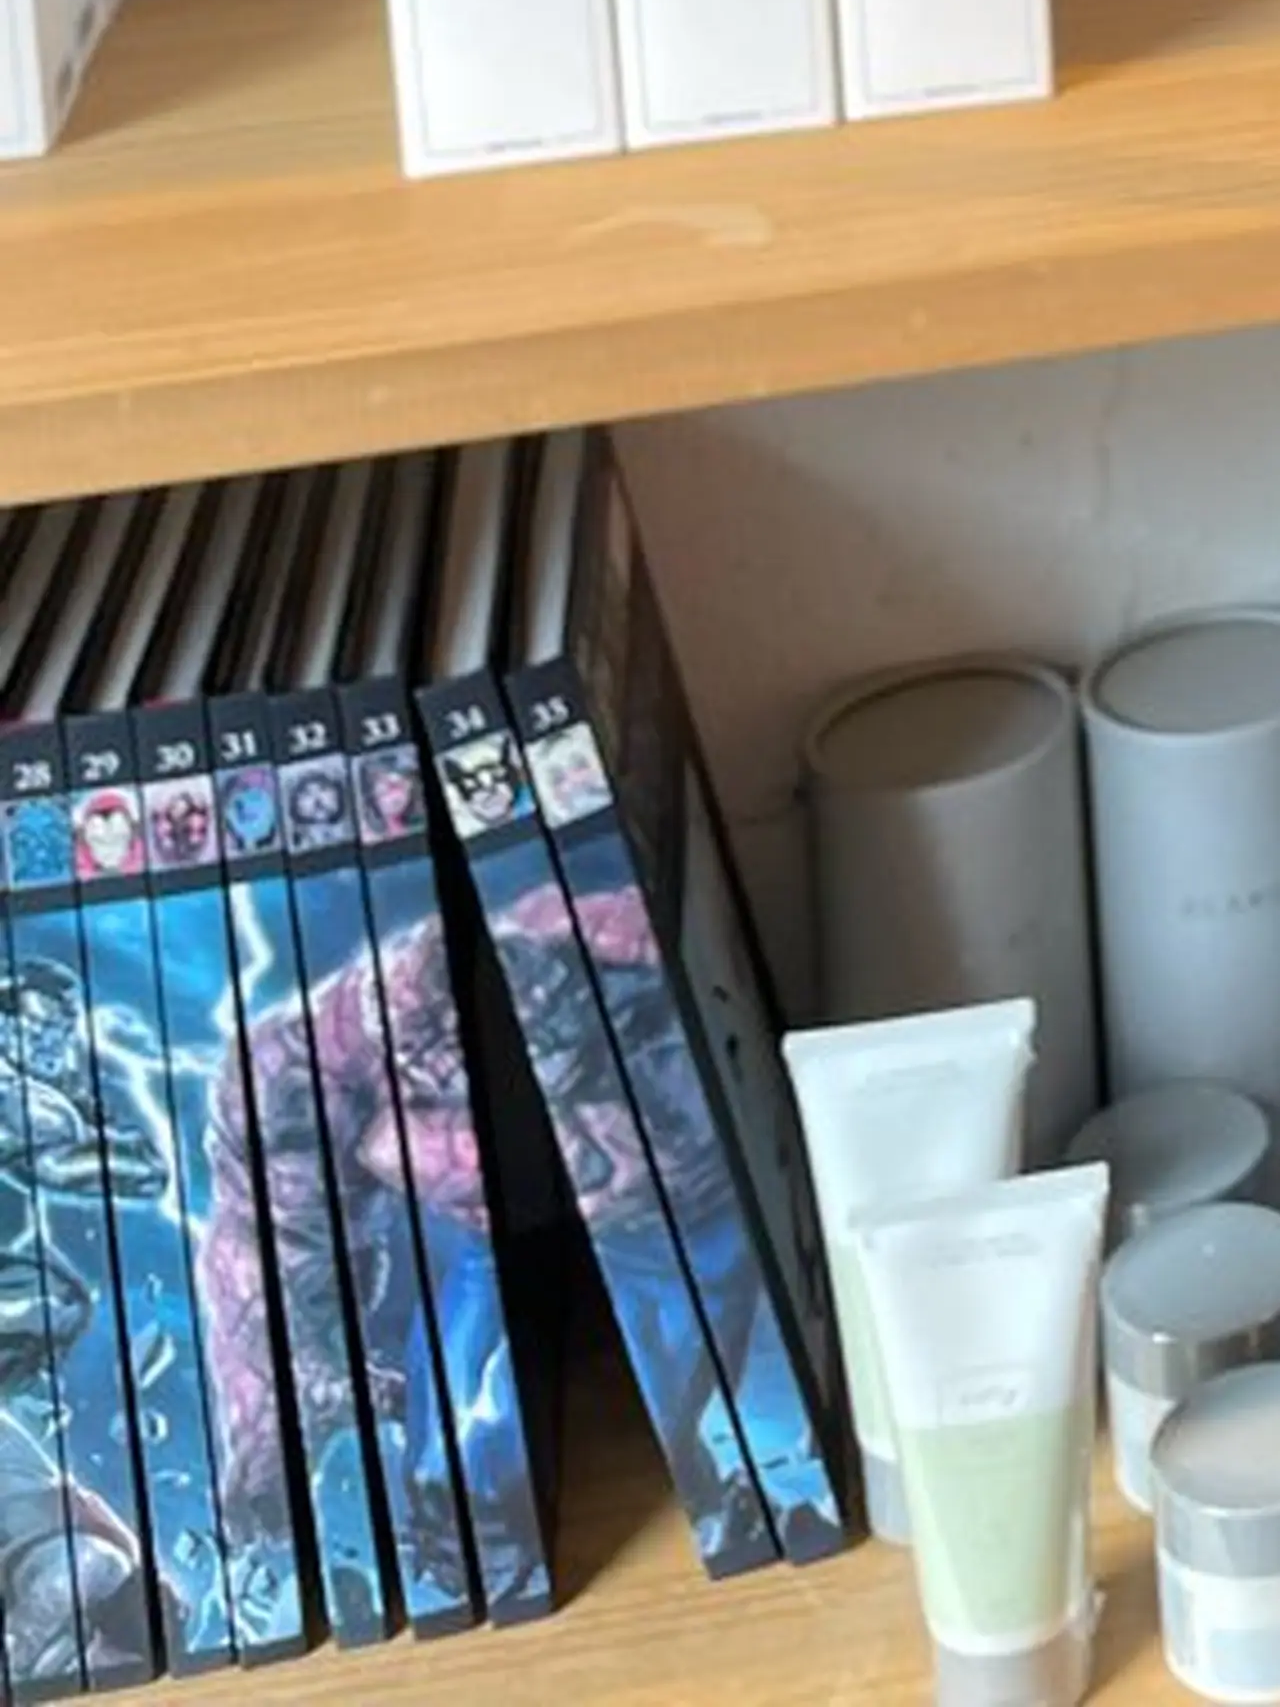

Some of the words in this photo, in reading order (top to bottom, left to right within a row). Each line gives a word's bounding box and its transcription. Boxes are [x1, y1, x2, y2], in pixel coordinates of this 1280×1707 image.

[289, 721, 327, 755] 32
[361, 713, 400, 747] 33
[446, 704, 486, 739] 34
[154, 740, 196, 774] 30
[220, 730, 258, 762] 31
[80, 749, 121, 782] 29
